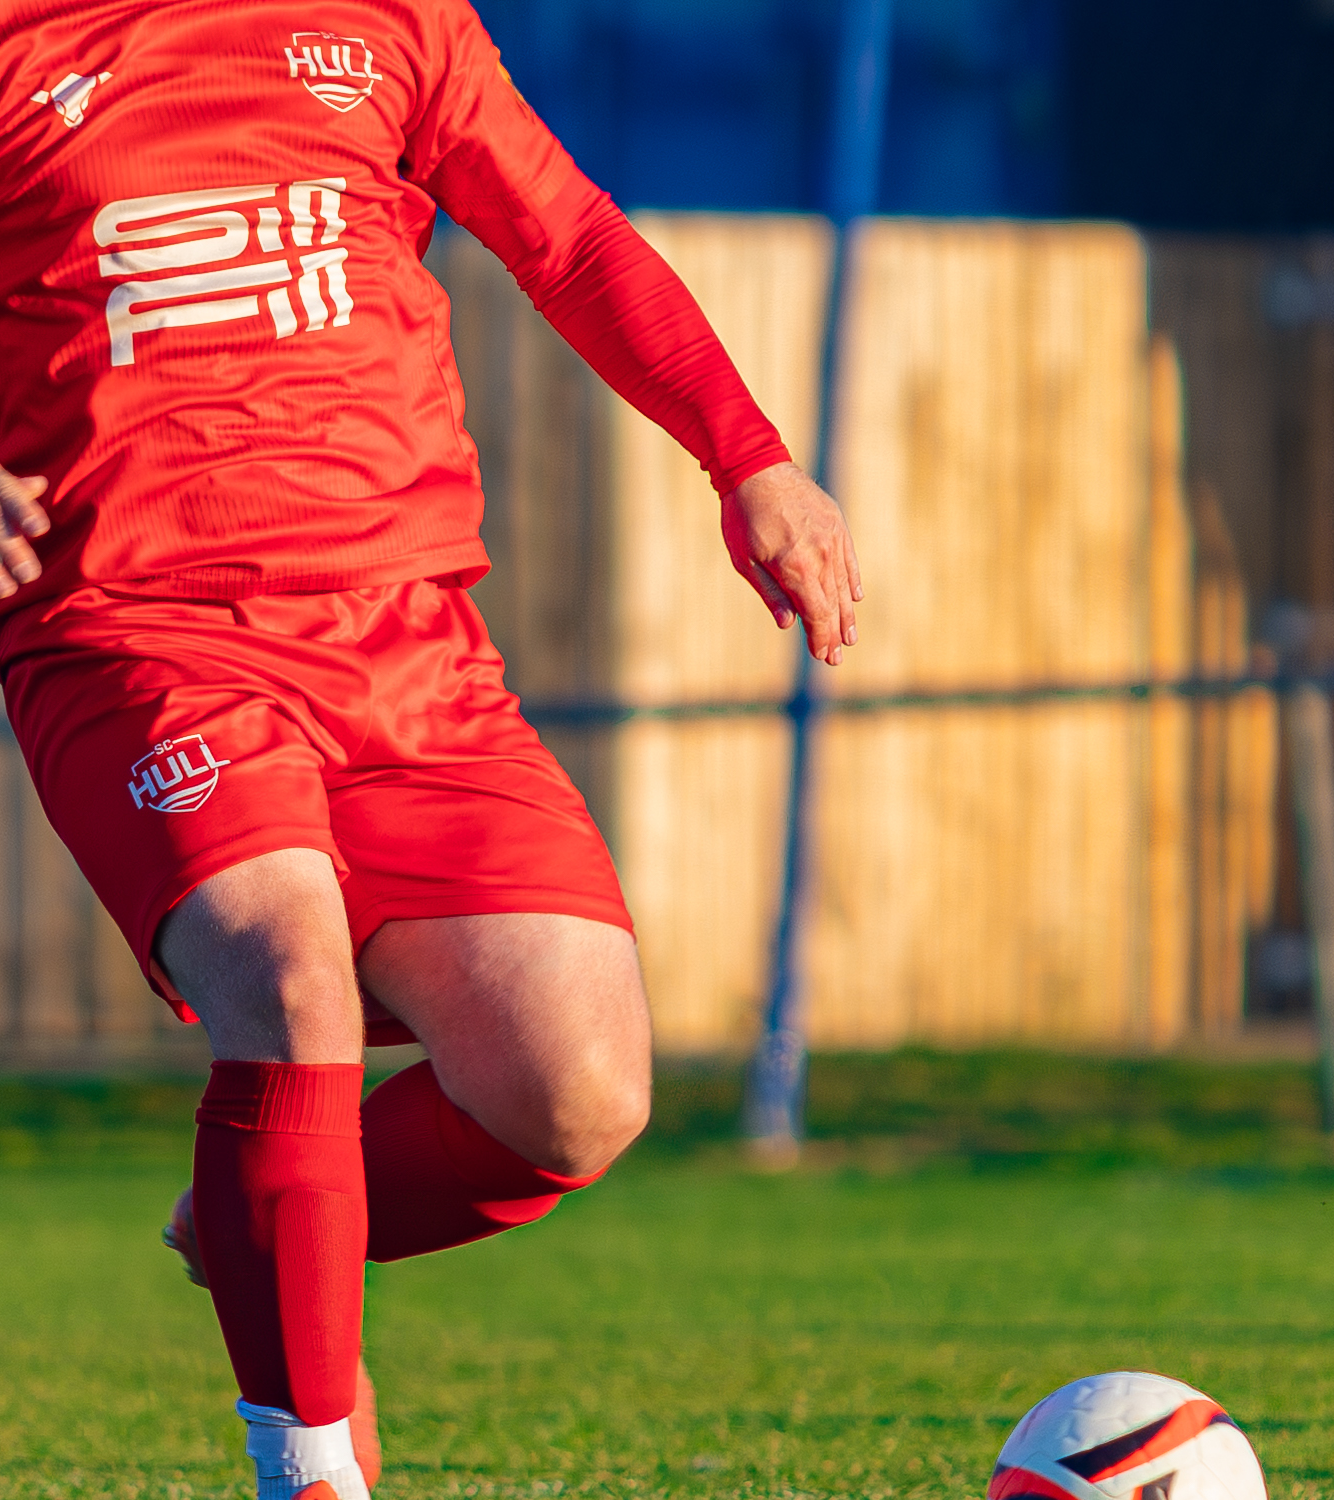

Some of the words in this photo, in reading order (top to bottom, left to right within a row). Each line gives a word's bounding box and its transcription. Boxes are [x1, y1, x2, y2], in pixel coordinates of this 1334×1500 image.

[283, 44, 384, 81] HULL
[154, 738, 174, 755] SC
[127, 743, 232, 810] HULL
